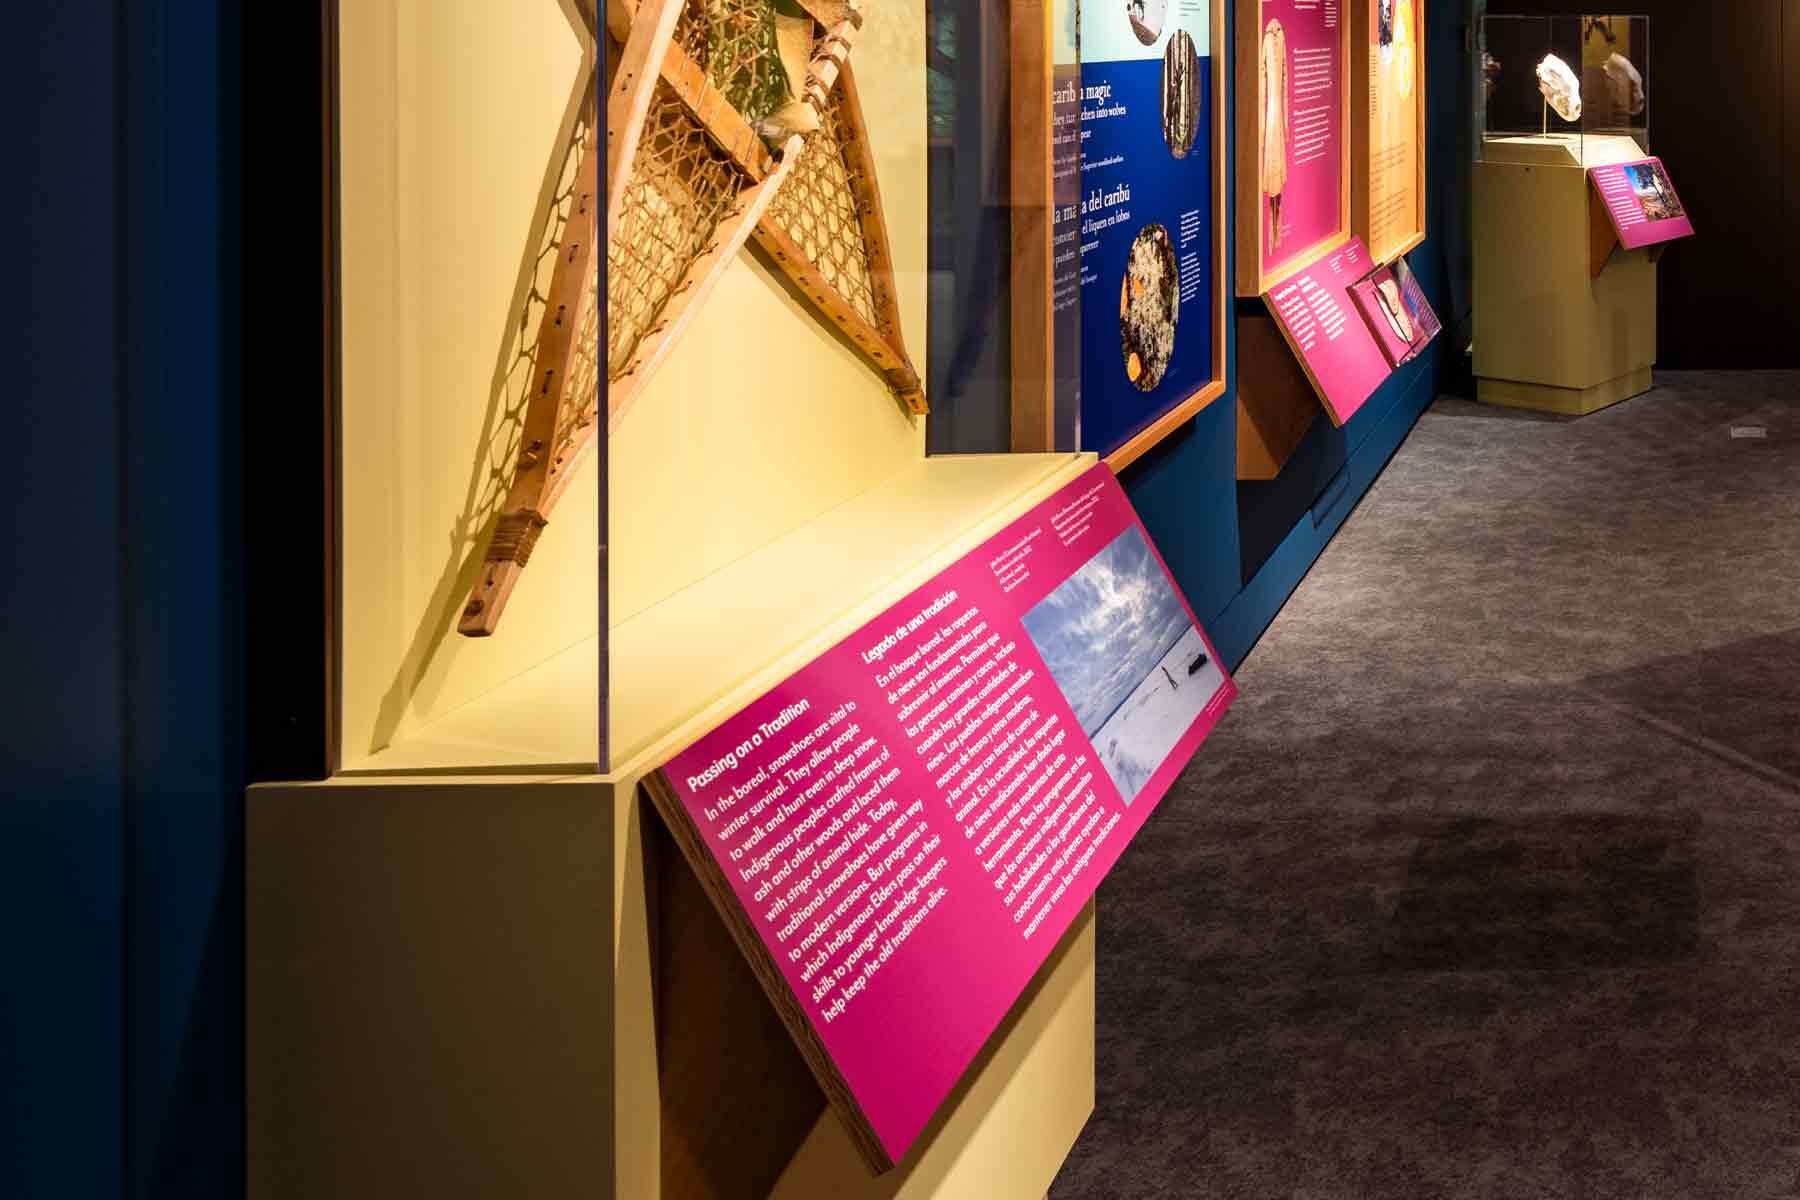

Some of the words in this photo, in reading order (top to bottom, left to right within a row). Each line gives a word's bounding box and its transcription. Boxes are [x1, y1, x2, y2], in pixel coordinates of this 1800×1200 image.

[1086, 80, 1111, 105] magic
[1096, 107, 1108, 119] into
[1064, 200, 1087, 221] maa
[1089, 188, 1102, 213] del
[1104, 183, 1130, 208] caribú
[1082, 219, 1088, 235] el
[1108, 216, 1116, 227] en
[1116, 208, 1131, 224] lobos
[861, 635, 898, 664] Legado
[895, 626, 909, 640] de
[906, 613, 926, 632] una
[921, 590, 958, 620] tradición
[687, 752, 738, 792] Passing
[736, 740, 754, 758] on
[752, 733, 763, 746] a
[758, 698, 810, 738] Tradition
[704, 808, 719, 821] In
[717, 795, 736, 812] the
[732, 767, 770, 799] boreal,
[768, 733, 816, 773] snowshoes
[814, 722, 830, 737] are
[828, 704, 847, 726] vital
[845, 701, 857, 712] to
[718, 812, 749, 840] winter
[749, 780, 788, 816] survival.
[784, 764, 810, 784] They
[809, 745, 833, 768] allow
[832, 723, 860, 752] people
[730, 848, 743, 861] to
[742, 825, 767, 851] walk
[766, 808, 786, 832] and
[782, 793, 806, 816] hunt
[805, 778, 827, 798] even
[825, 770, 836, 782] in
[834, 754, 855, 774] deep
[854, 737, 878, 758] snow.
[739, 834, 794, 881] Indigenous
[793, 805, 827, 841] peoples
[826, 776, 856, 808] crafted
[852, 757, 882, 784] frames
[880, 745, 890, 761] of
[754, 880, 773, 901] ash
[772, 860, 792, 885] and
[791, 842, 815, 868] other
[815, 817, 844, 846] woods
[842, 799, 861, 822] and
[856, 780, 881, 807] laced
[879, 767, 901, 788] them
[765, 897, 788, 921] with
[787, 876, 813, 903] strips
[811, 861, 822, 879] of
[822, 835, 852, 869] animal
[848, 822, 872, 843] hide.
[867, 798, 898, 822] Today,
[777, 889, 826, 942] traditional
[824, 851, 870, 897] snowshoes
[865, 833, 888, 855] have
[886, 814, 908, 840] given
[906, 799, 924, 817] way
[788, 948, 801, 962] to
[800, 913, 836, 951] modern
[834, 880, 871, 916] versions.
[867, 862, 885, 881] But
[884, 829, 921, 871] programs
[917, 821, 928, 832] in
[800, 950, 829, 982] which
[825, 904, 875, 954] Indigenous
[870, 880, 898, 908] Elders
[896, 862, 916, 887] pass
[913, 852, 925, 865] on
[922, 834, 941, 855] their
[813, 976, 836, 1003] skills
[833, 966, 846, 979] to
[844, 929, 878, 971] younger
[875, 856, 948, 933] knowledge-keepers
[822, 998, 846, 1022] help
[841, 975, 866, 1000] keep
[864, 959, 881, 977] the
[879, 940, 894, 962] old
[891, 905, 929, 947] traditions
[927, 887, 948, 909] alive.
